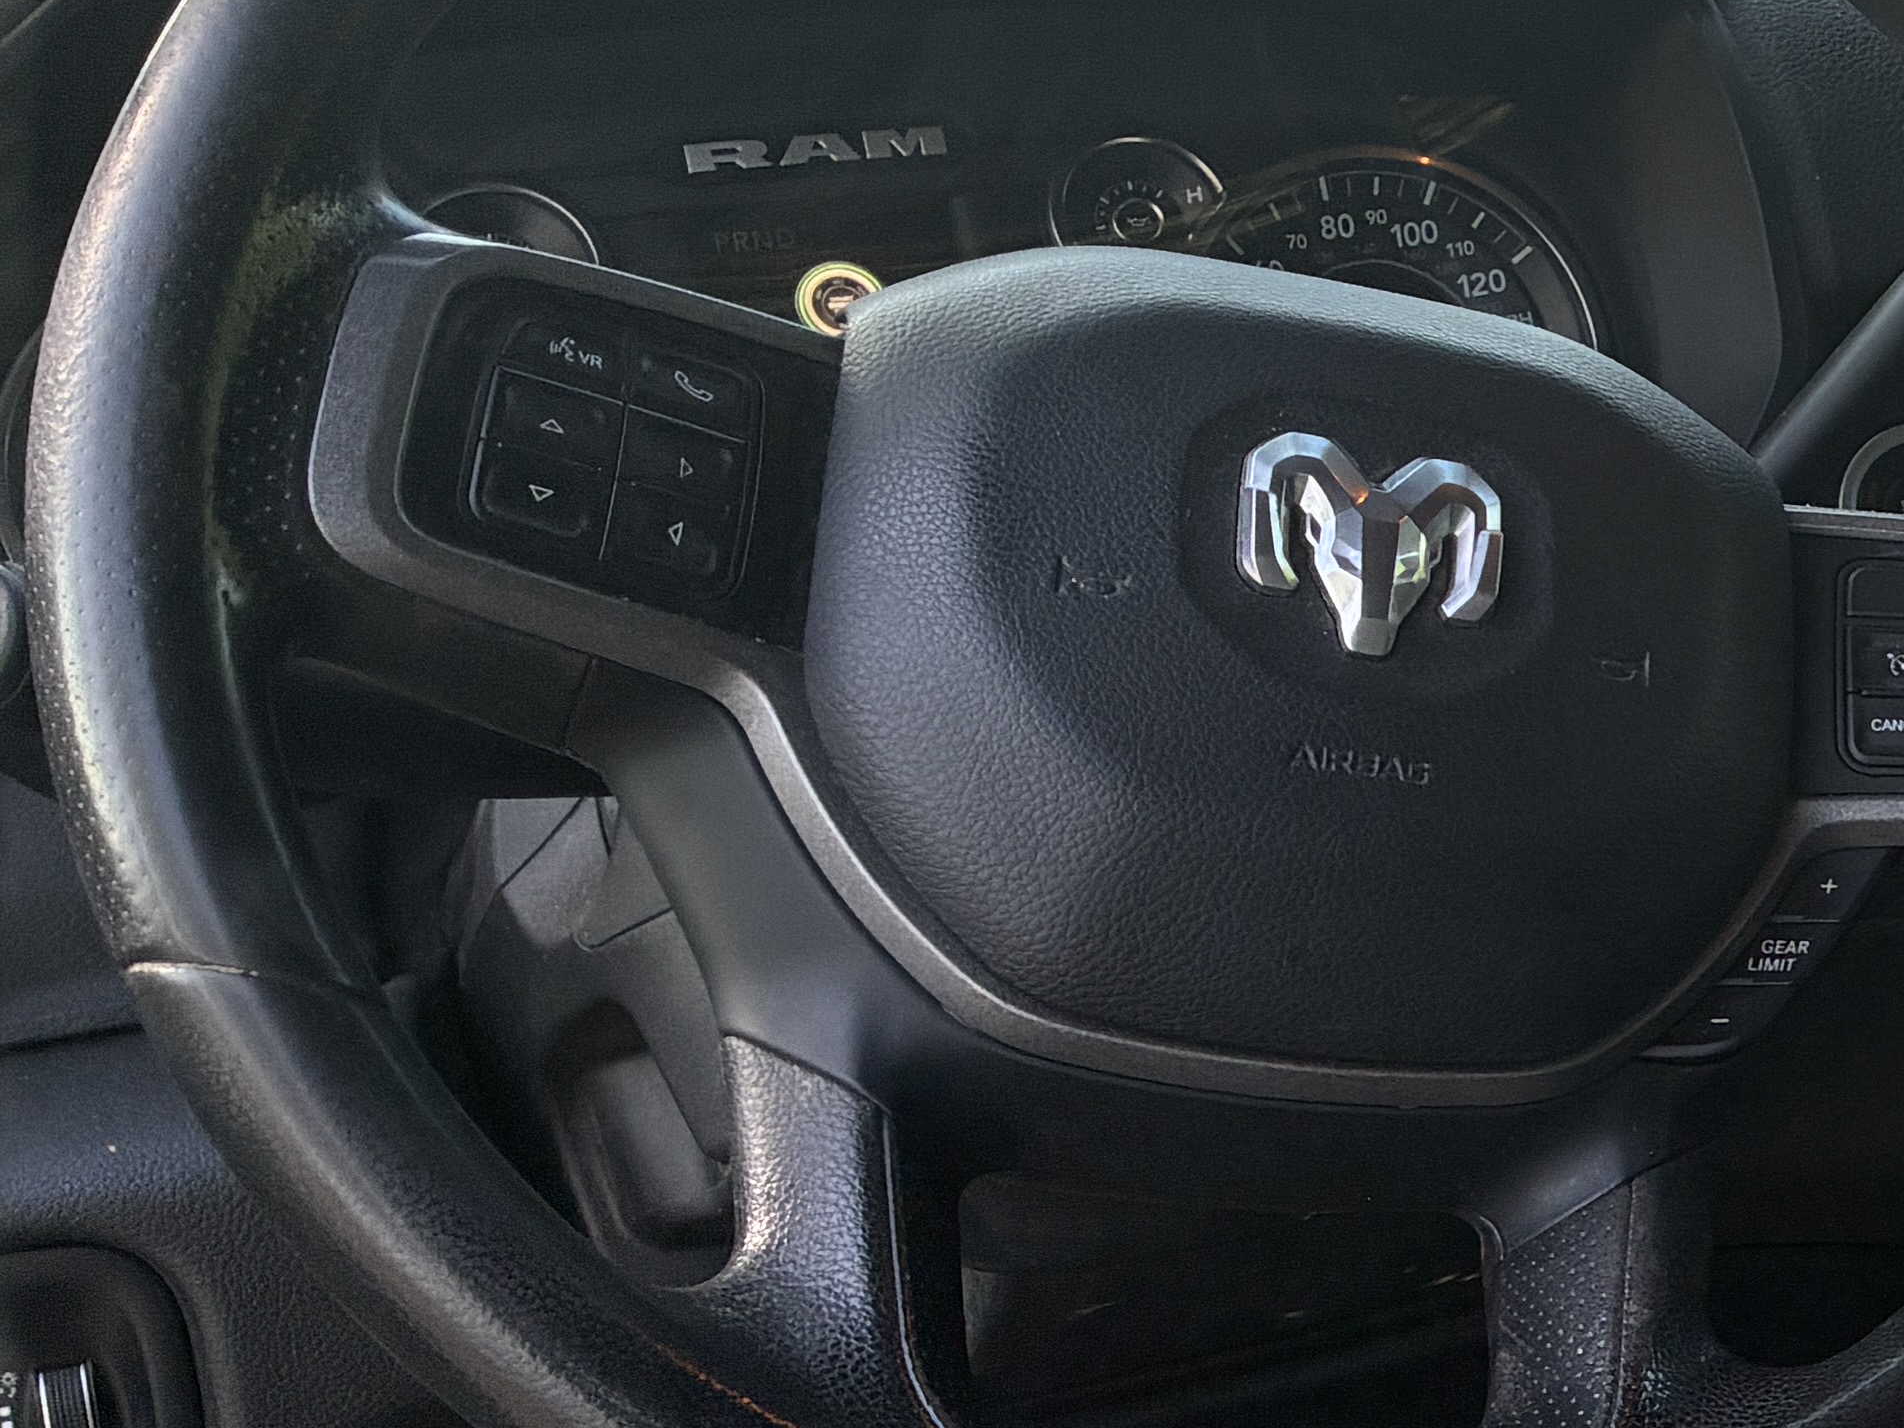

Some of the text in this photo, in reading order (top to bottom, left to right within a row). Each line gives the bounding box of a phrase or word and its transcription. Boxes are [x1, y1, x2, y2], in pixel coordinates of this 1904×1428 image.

[683, 126, 947, 174] RAM
[1185, 185, 1203, 204] H
[1320, 213, 1355, 240] 80
[1365, 209, 1387, 225] 90
[1286, 233, 1308, 249] 70
[1390, 219, 1438, 248] 100
[1446, 240, 1475, 258] 110
[1456, 269, 1506, 299] 120
[578, 350, 602, 370] VR
[1290, 742, 1431, 785] AIRBAG
[1761, 939, 1811, 954] GEAR
[1747, 957, 1798, 972] LIMIT
